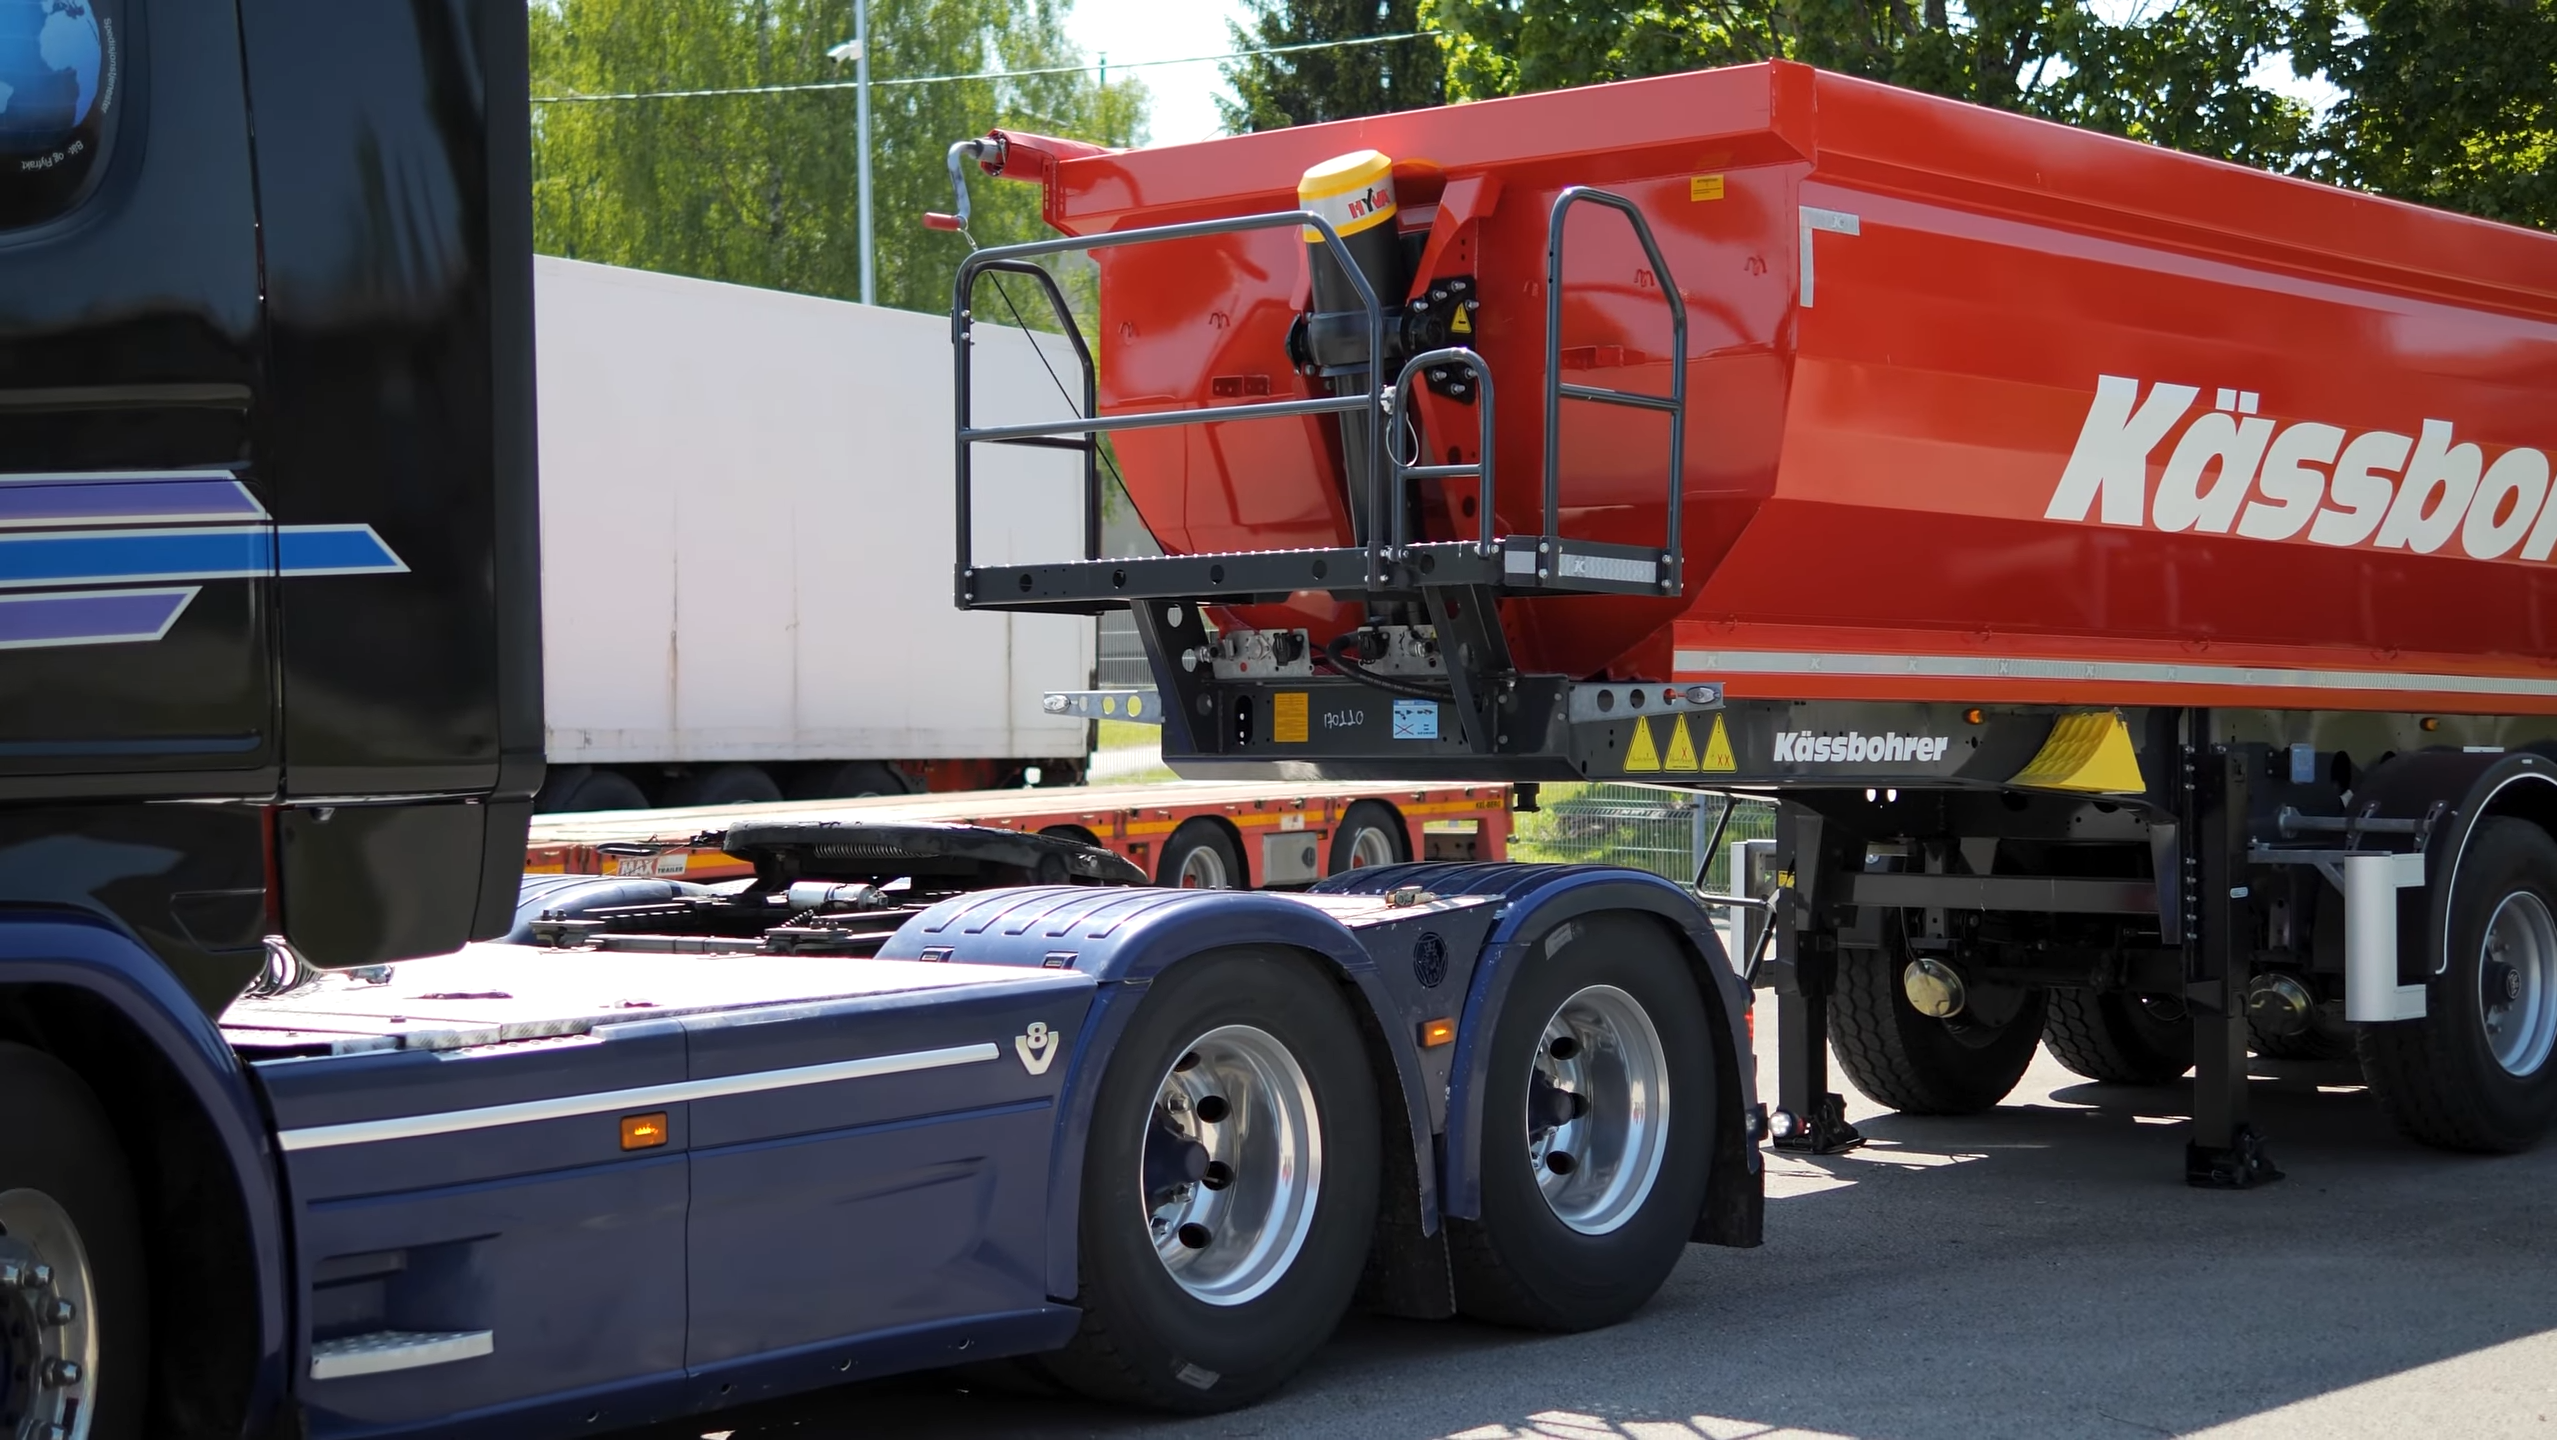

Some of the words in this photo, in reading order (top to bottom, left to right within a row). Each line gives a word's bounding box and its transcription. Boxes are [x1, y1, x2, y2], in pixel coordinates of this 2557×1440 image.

[52, 152, 65, 163] og
[1347, 187, 1391, 219] HYVA
[1773, 730, 1948, 762] Kässbohrer
[620, 859, 653, 876] MAX
